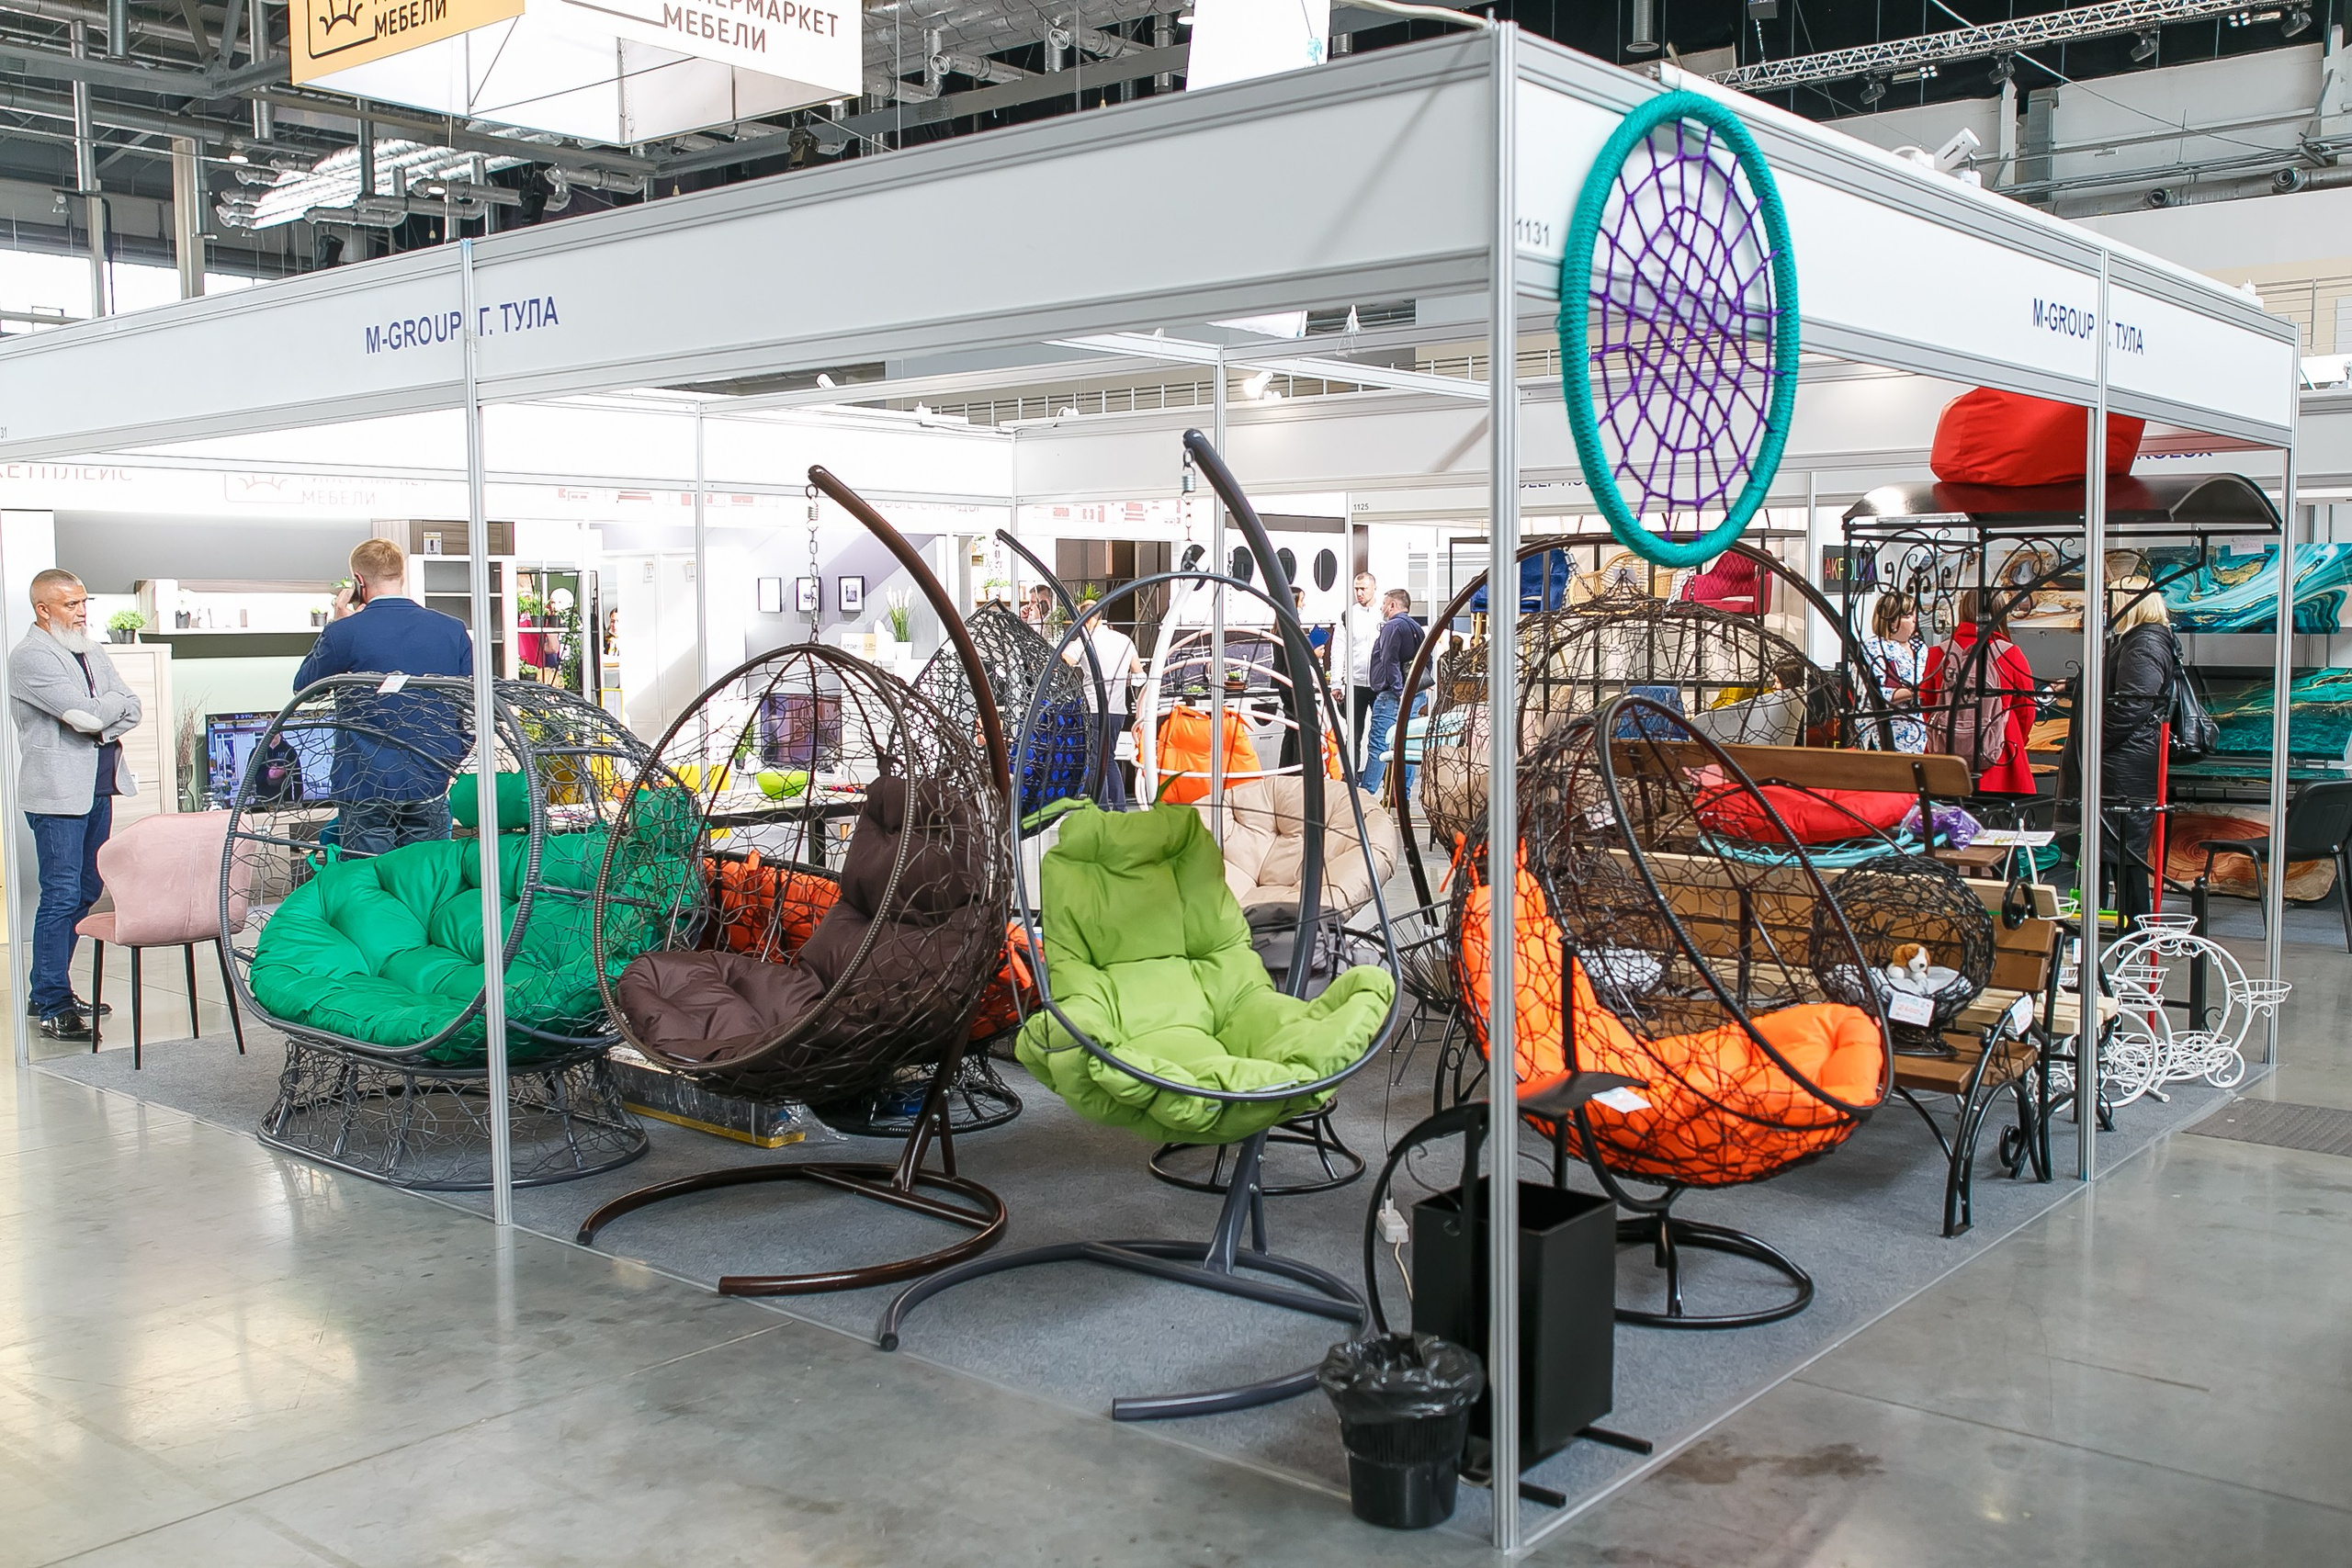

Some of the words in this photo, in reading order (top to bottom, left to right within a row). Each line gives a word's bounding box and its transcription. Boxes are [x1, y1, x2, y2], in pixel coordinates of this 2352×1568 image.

[374, 0, 447, 39] МЕБЕЛИ
[663, 3, 766, 53] МЕБЕЛИ
[698, 0, 839, 38] МАРКЕТ
[1515, 219, 1549, 248] 1131
[366, 310, 462, 355] M-GROUP
[479, 306, 493, 337] Г.
[500, 296, 560, 333] ТУЛА
[2032, 298, 2095, 341] M-GROUP
[2115, 321, 2144, 355] ТУЛА
[302, 490, 376, 506] МЕБЕЛИ
